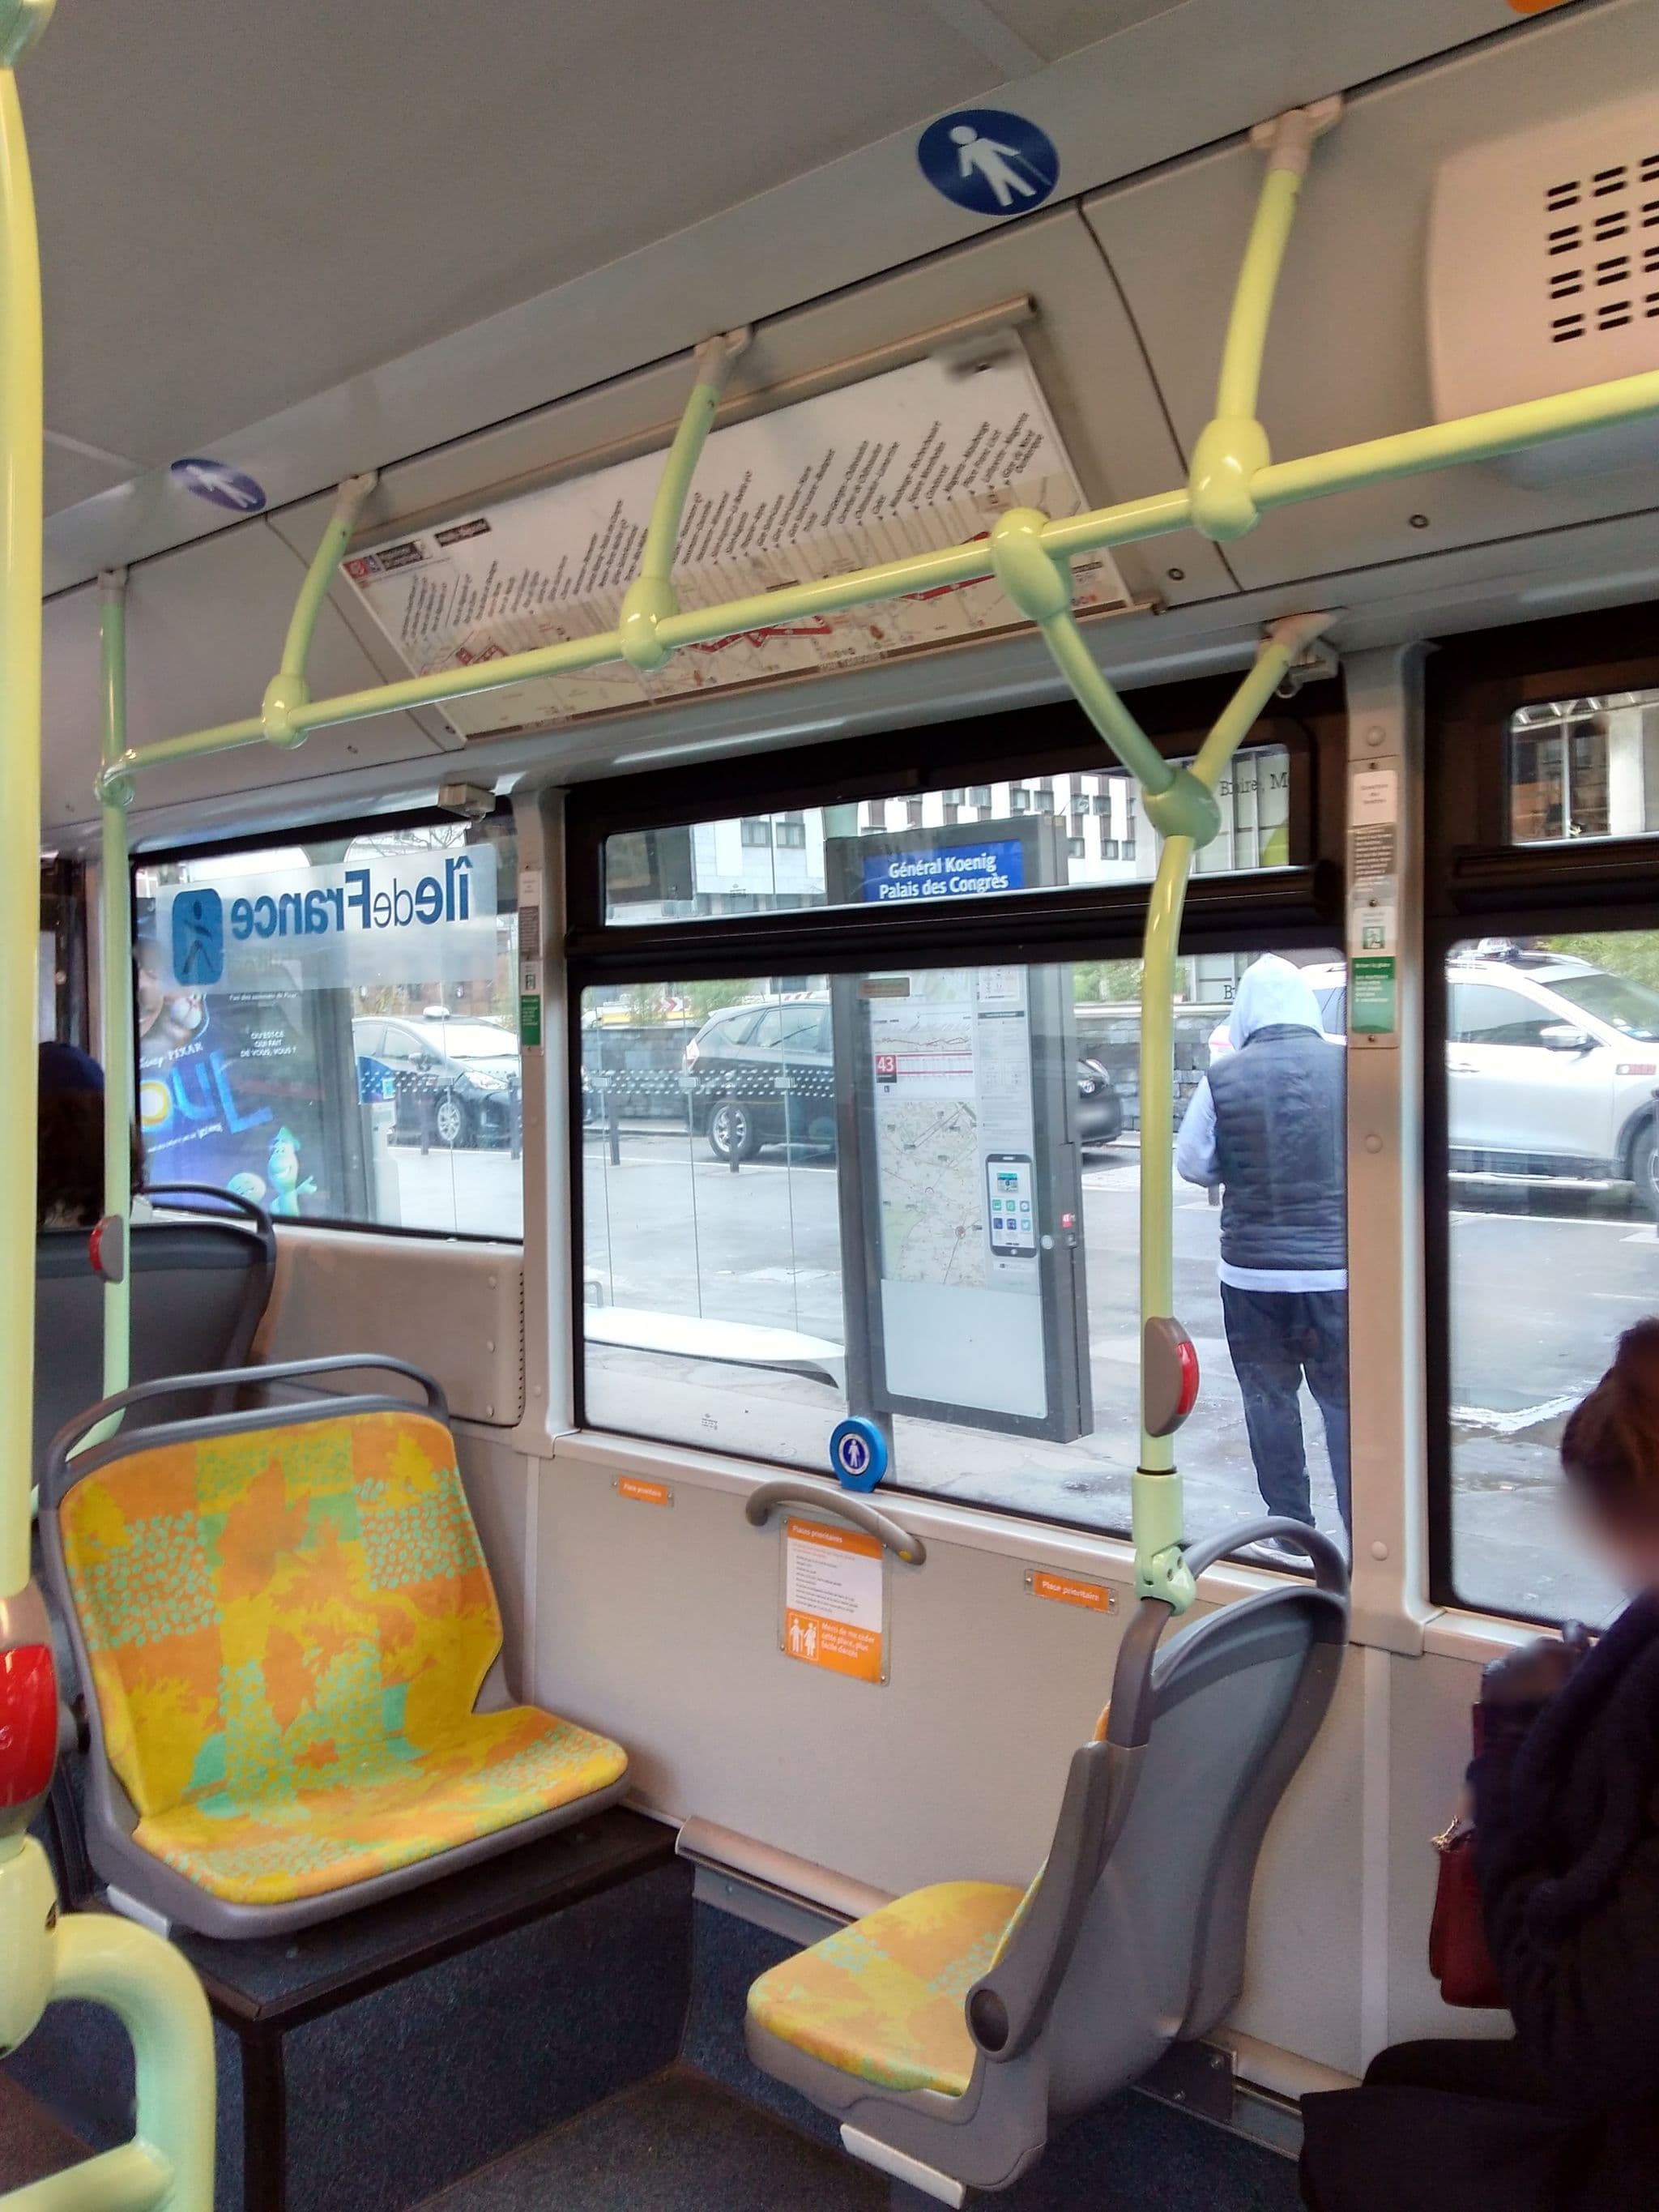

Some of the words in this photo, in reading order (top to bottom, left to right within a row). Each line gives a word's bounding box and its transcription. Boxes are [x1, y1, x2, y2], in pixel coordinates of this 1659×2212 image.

[889, 858, 941, 878] Général
[945, 852, 996, 873] Koenig
[880, 881, 919, 899] Palais
[923, 879, 947, 895] des
[949, 873, 1009, 893] Congrès
[167, 1041, 203, 1061] PIXAR
[876, 1056, 895, 1072] 43
[1042, 1581, 1061, 1591] Place
[1063, 1587, 1099, 1601] prioritaire
